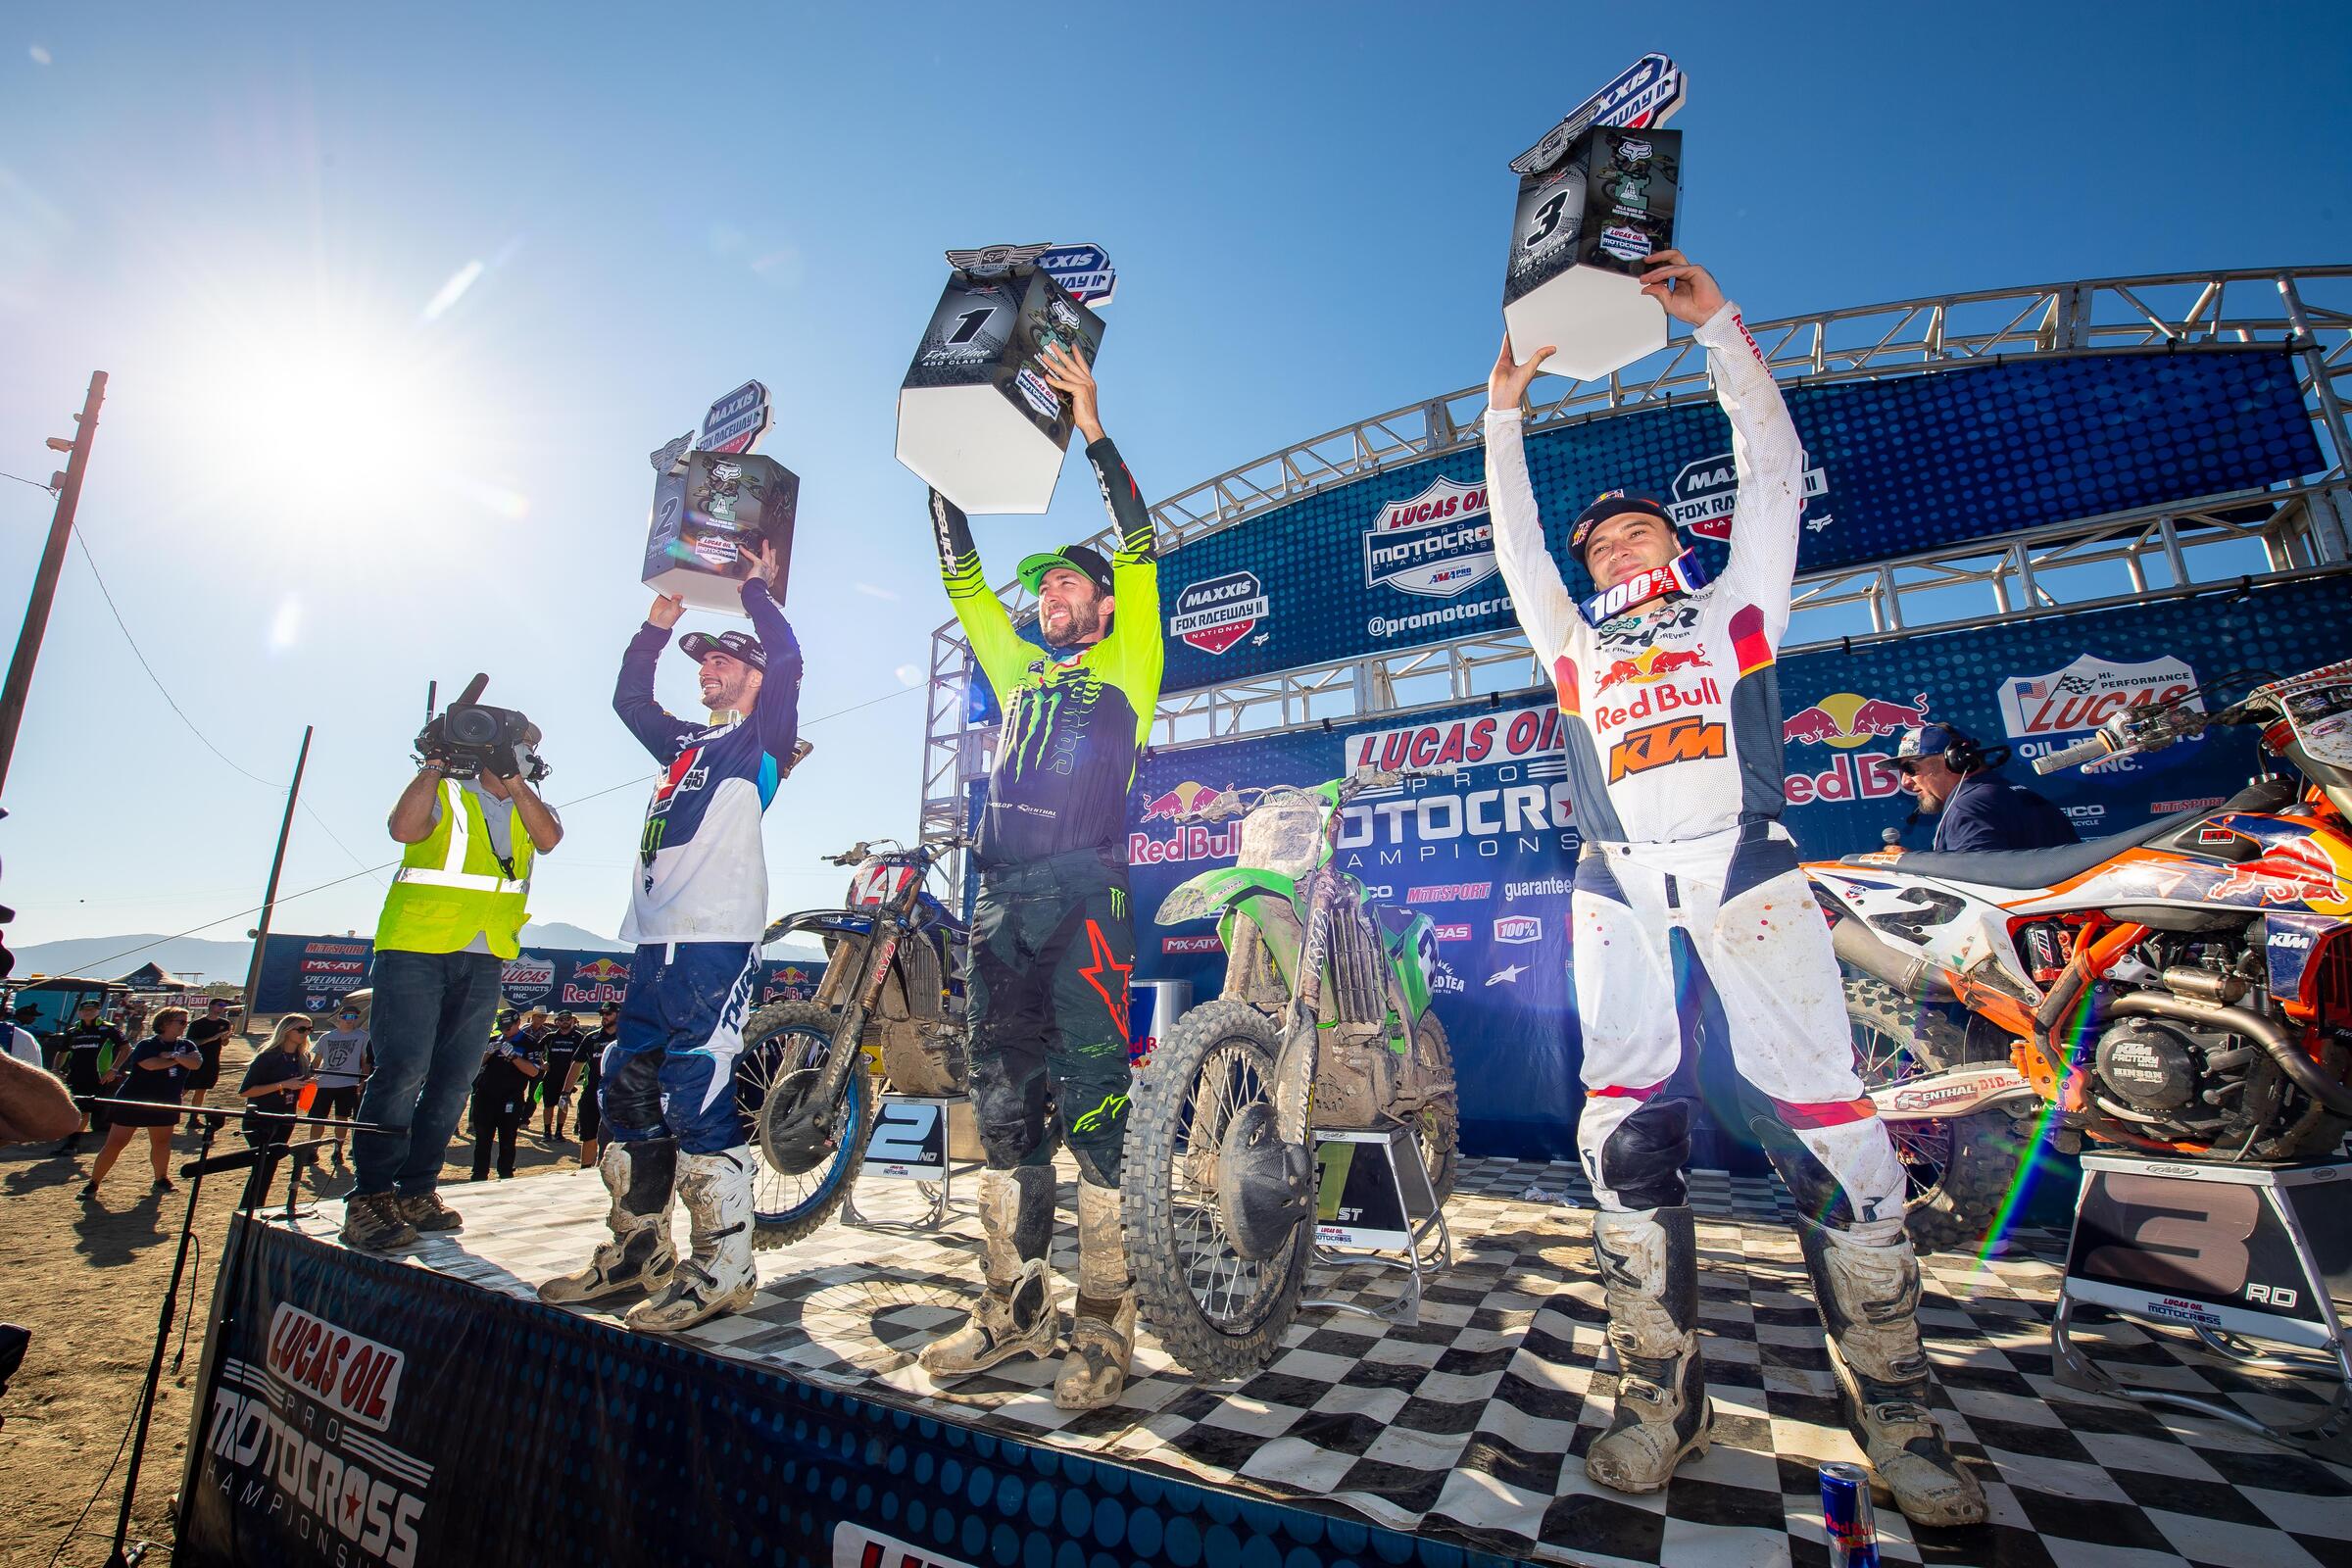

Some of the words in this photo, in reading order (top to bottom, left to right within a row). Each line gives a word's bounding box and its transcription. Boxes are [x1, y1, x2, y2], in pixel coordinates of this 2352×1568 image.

[1592, 63, 1653, 120] XXIS
[1525, 189, 1570, 249] 3
[1603, 237, 1649, 252] MOTOCROSS
[1610, 229, 1632, 240] LUCAS
[1039, 254, 1095, 269] XXIS
[1537, 243, 1565, 265] CLASS
[945, 307, 998, 345] 1
[921, 350, 956, 361] First
[1028, 373, 1046, 392] LUCAS
[1046, 390, 1054, 401] OIL
[709, 391, 755, 427] MAXXIS
[714, 415, 753, 445] RACEWAY
[1688, 464, 1740, 492] MAX
[654, 496, 679, 539] 2
[1389, 496, 1458, 529] LUCAS
[1675, 503, 1708, 522] FOX
[932, 490, 957, 576] alpinesta
[1373, 524, 1494, 564] MOTOCRO
[1426, 523, 1465, 537] PRO
[1022, 560, 1069, 576] Kawasaki
[1373, 542, 1488, 571] CHAMPIONS
[1427, 570, 1455, 584] AMA
[1186, 579, 1250, 608] MAXXIS
[1591, 567, 1674, 621] 100%
[1176, 615, 1198, 631] FOX
[1199, 603, 1254, 627] RACEWAY
[1255, 600, 1264, 615] II
[1368, 596, 1515, 637] @promotocro
[1192, 623, 1247, 639] NATIONAL
[2101, 672, 2190, 689] PERFORMANCE
[1595, 689, 1652, 734] Red
[1655, 677, 1722, 712] Bull
[1357, 716, 1496, 772] LUCAS
[1608, 714, 1727, 786] KTM
[1412, 765, 1517, 793] PRO
[1785, 753, 1855, 805] ed
[1129, 820, 1185, 865] Red
[1189, 820, 1243, 860] Bull
[1348, 833, 1580, 868] AMPIONS
[855, 866, 906, 906] 14
[1505, 876, 1576, 902] guarantee
[1436, 926, 1468, 939] GAS
[1500, 921, 1536, 937] 100%
[2268, 933, 2310, 949] KTM
[302, 975, 363, 984] SPECIALIZED
[502, 970, 551, 983] LUCAS
[1446, 974, 1465, 992] TEA
[563, 983, 600, 1003] Red
[1128, 1035, 1144, 1054] ed
[864, 1103, 938, 1161] 2
[919, 1152, 938, 1162] ND
[1317, 1142, 1356, 1221] 1
[1338, 1207, 1363, 1221] ST
[2083, 1172, 2260, 1296] 3
[2245, 1282, 2297, 1308] RD
[2147, 1304, 2222, 1325] MOTOCROSS
[2163, 1298, 2188, 1309] LUCAS
[2190, 1302, 2203, 1311] OIL
[1223, 1329, 1267, 1350] DUNLOP
[270, 1310, 351, 1398] LUCAS
[340, 1345, 398, 1422] OIL
[283, 1395, 339, 1443] PRO
[207, 1387, 426, 1568] MOTOCROSS
[205, 1460, 370, 1568] HAMPIONS
[1825, 1512, 1850, 1536] Red
[1852, 1520, 1875, 1538] Bull
